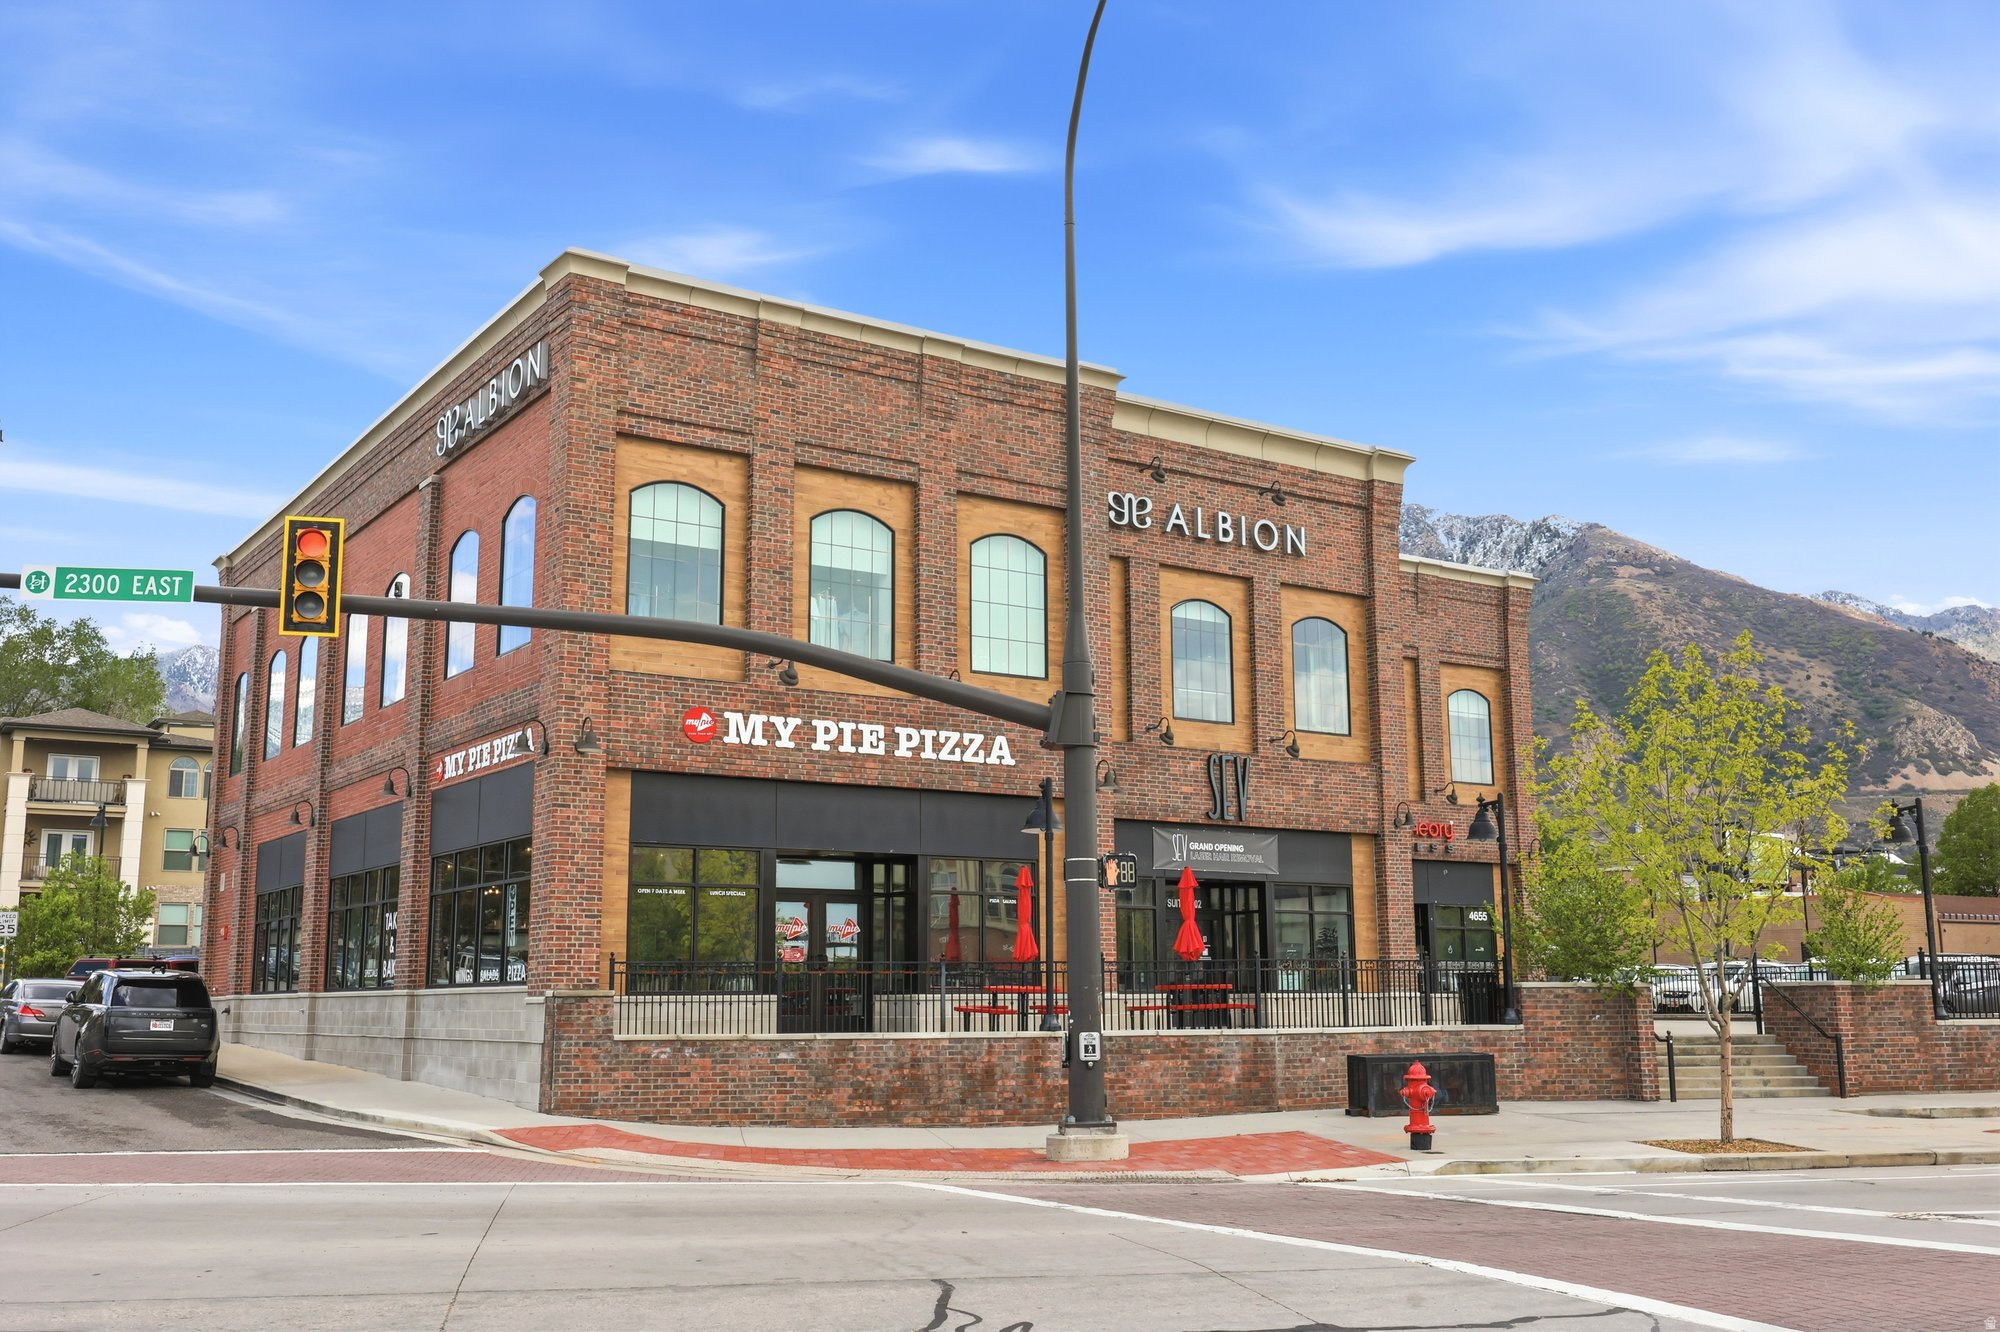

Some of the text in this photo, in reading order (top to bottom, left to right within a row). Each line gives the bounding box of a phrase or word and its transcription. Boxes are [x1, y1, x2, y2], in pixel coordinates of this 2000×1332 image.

[463, 340, 549, 437] ALBION
[1165, 502, 1306, 556] ALBION
[64, 573, 183, 596] 2300 EAST
[723, 711, 1015, 765] MY PIE PIZZA
[444, 751, 466, 779] MY
[468, 742, 490, 772] PIE
[1207, 753, 1250, 822] SEV
[1414, 821, 1455, 842] eory
[1172, 833, 1188, 862] SEV
[1189, 842, 1245, 853] GRAND OPENING
[1213, 852, 1230, 862] HAIR
[1231, 853, 1264, 864] REMOVAL
[1167, 898, 1181, 908] SUIT
[385, 911, 398, 931] TAK
[1469, 911, 1488, 921] 4655
[0, 924, 15, 934] 25
[389, 936, 395, 953] &
[382, 959, 397, 978] BAK
[456, 970, 473, 984] WINGS
[507, 964, 526, 982] PIZZA
